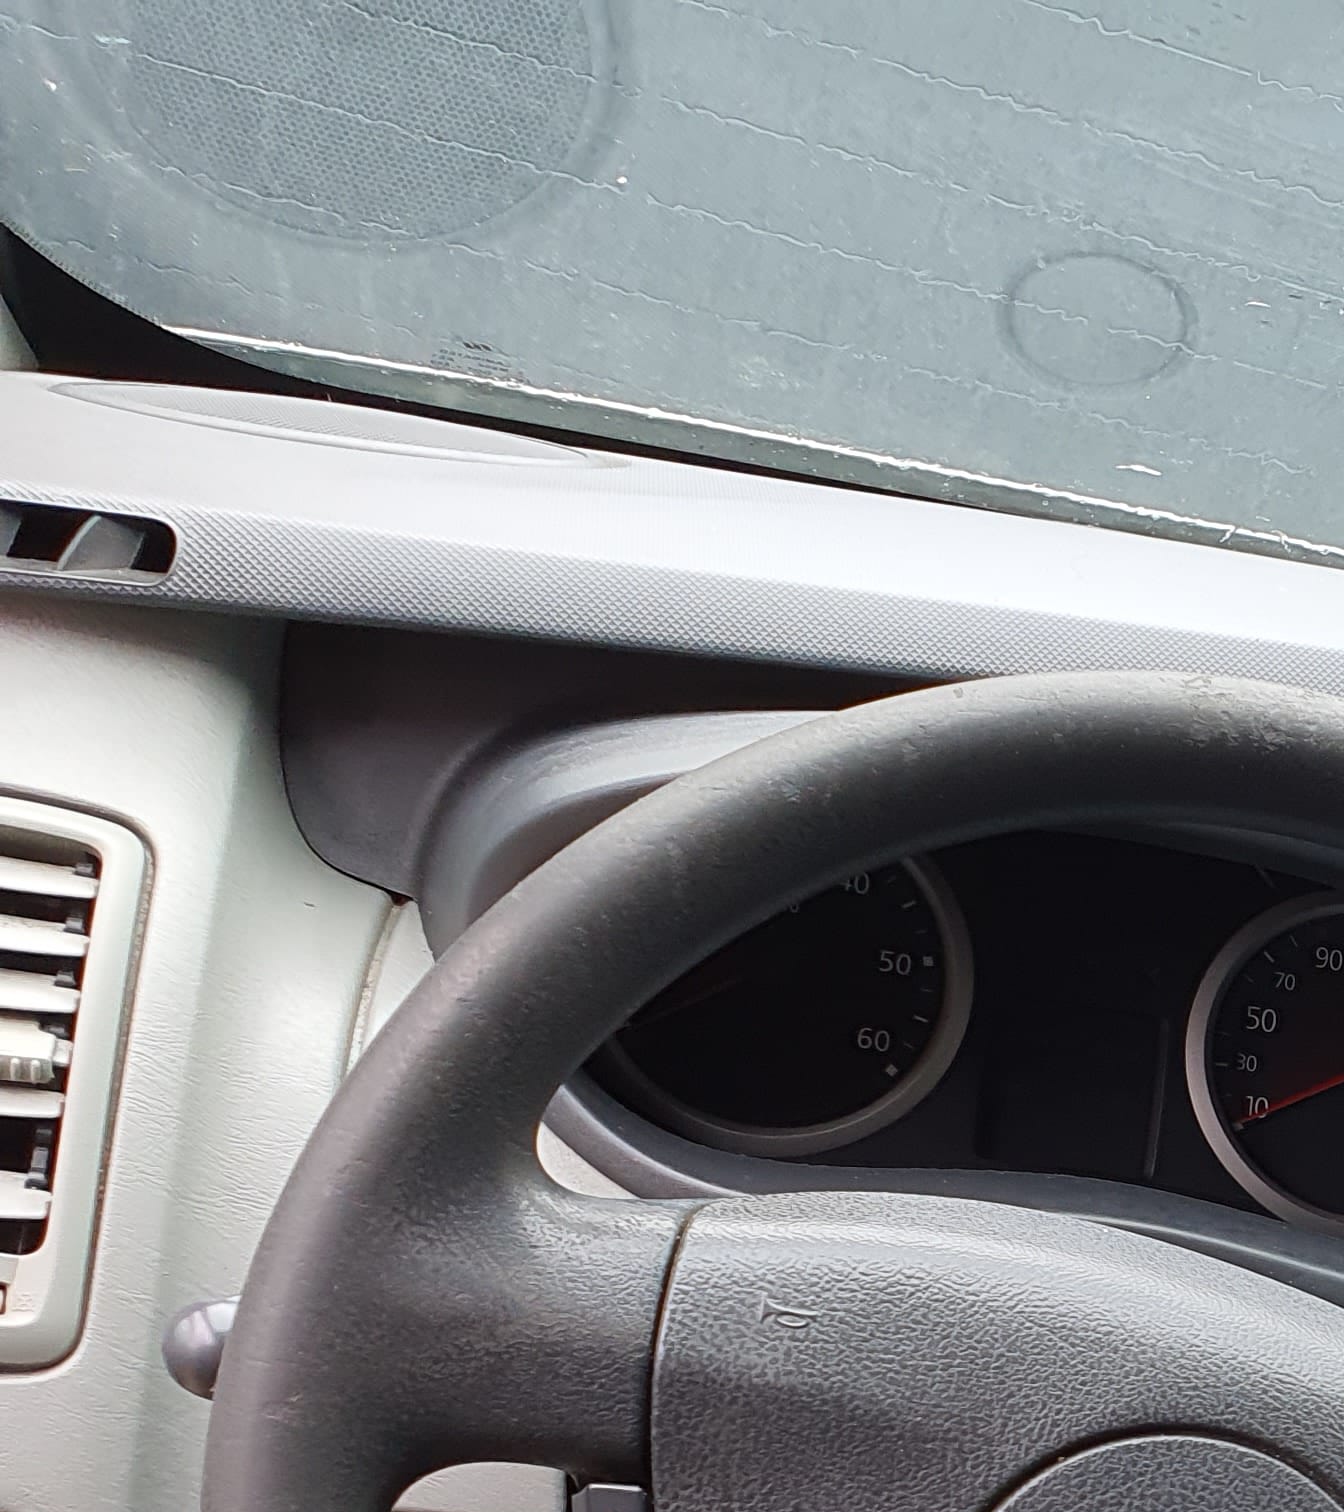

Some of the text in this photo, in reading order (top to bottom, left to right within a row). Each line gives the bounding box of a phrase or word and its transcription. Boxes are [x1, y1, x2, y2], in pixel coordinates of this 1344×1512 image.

[878, 950, 912, 976] 50
[1314, 946, 1344, 972] 90
[1272, 971, 1296, 991] 70
[1245, 1006, 1278, 1033] 50
[856, 1026, 891, 1052] 60
[1236, 1052, 1258, 1073] 30
[1245, 1095, 1270, 1119] 10
